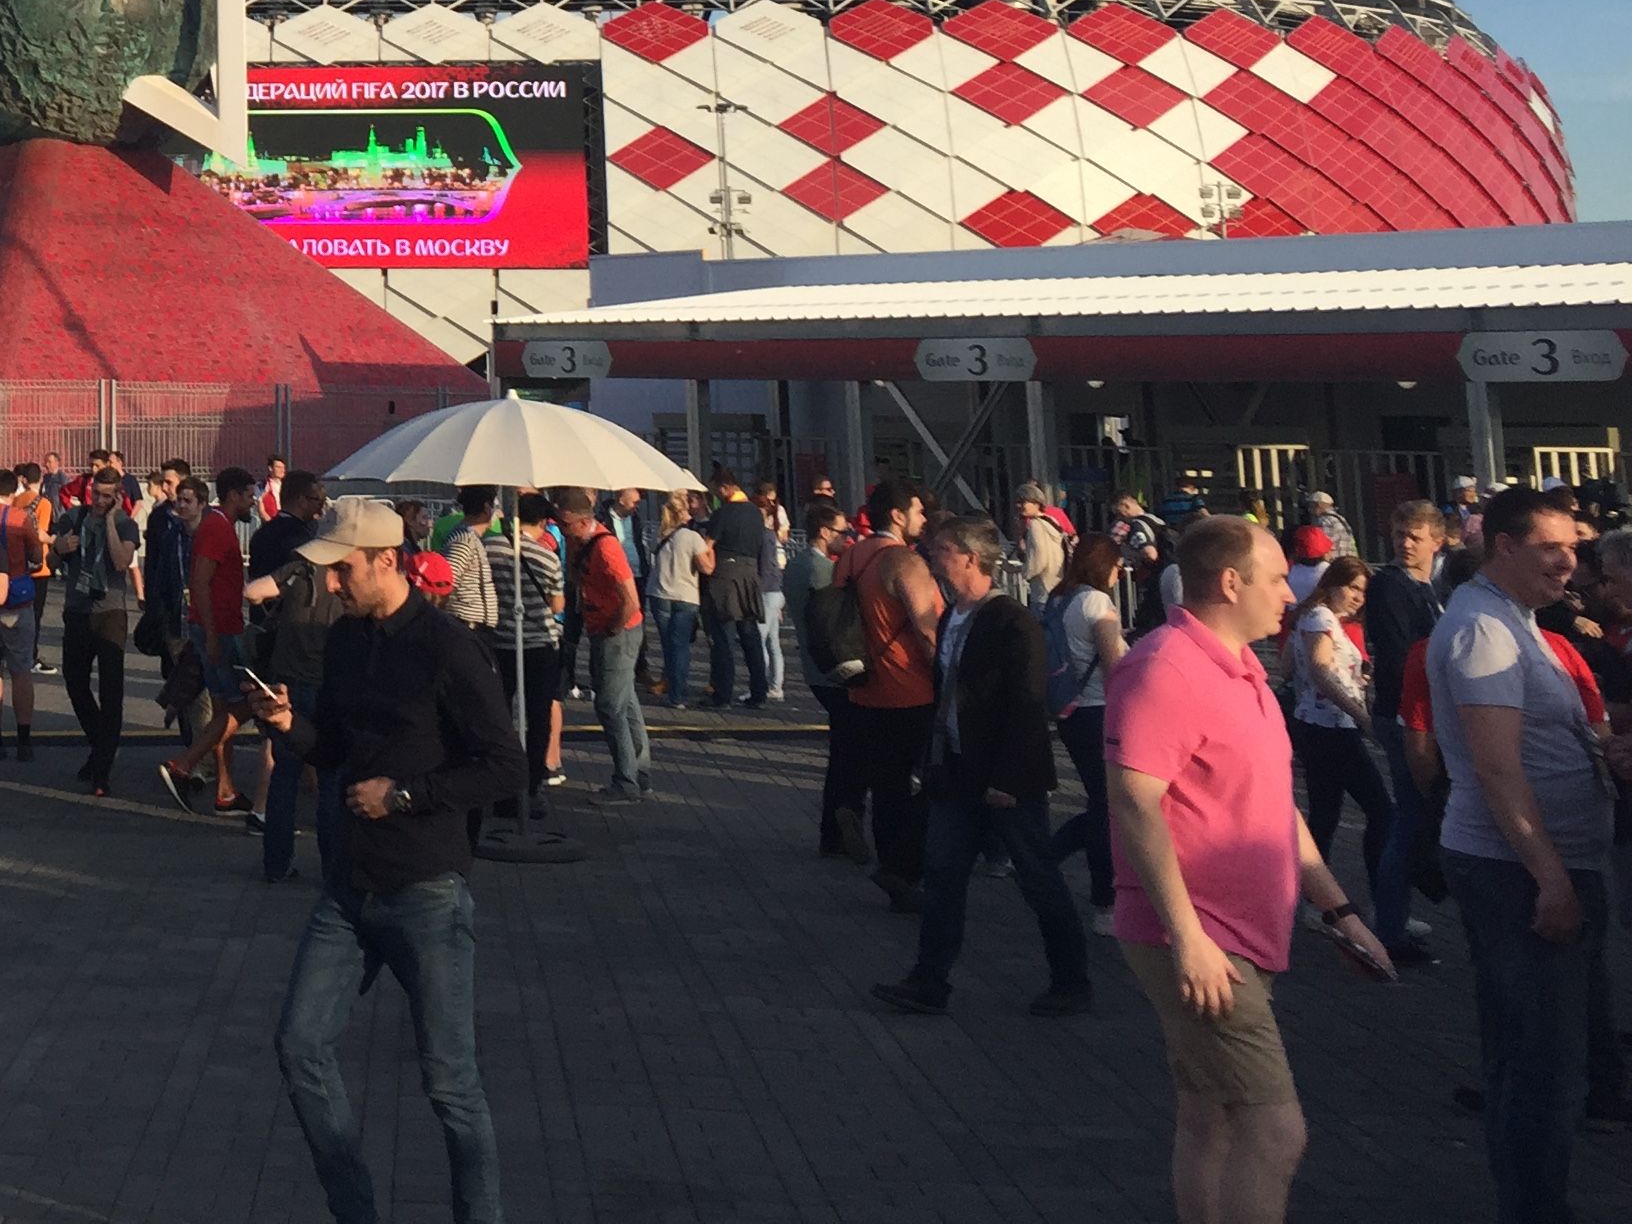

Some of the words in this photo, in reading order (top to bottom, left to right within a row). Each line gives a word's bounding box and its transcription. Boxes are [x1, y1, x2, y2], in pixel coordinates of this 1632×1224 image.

[247, 78, 348, 103] ДЕРАЦИЙ
[352, 82, 398, 99] FIFA
[401, 81, 448, 99] 2017
[453, 81, 469, 99] В
[473, 80, 566, 98] РОССИИ
[289, 238, 391, 256] ЛОВАТЬ
[395, 239, 410, 256] В
[415, 239, 509, 256] МОСКВУ
[560, 346, 577, 375] 3
[925, 351, 960, 368] Gate
[967, 344, 988, 376] 3
[1473, 347, 1521, 367] Gate
[1531, 338, 1560, 375] 3
[1572, 349, 1611, 368] Вход
